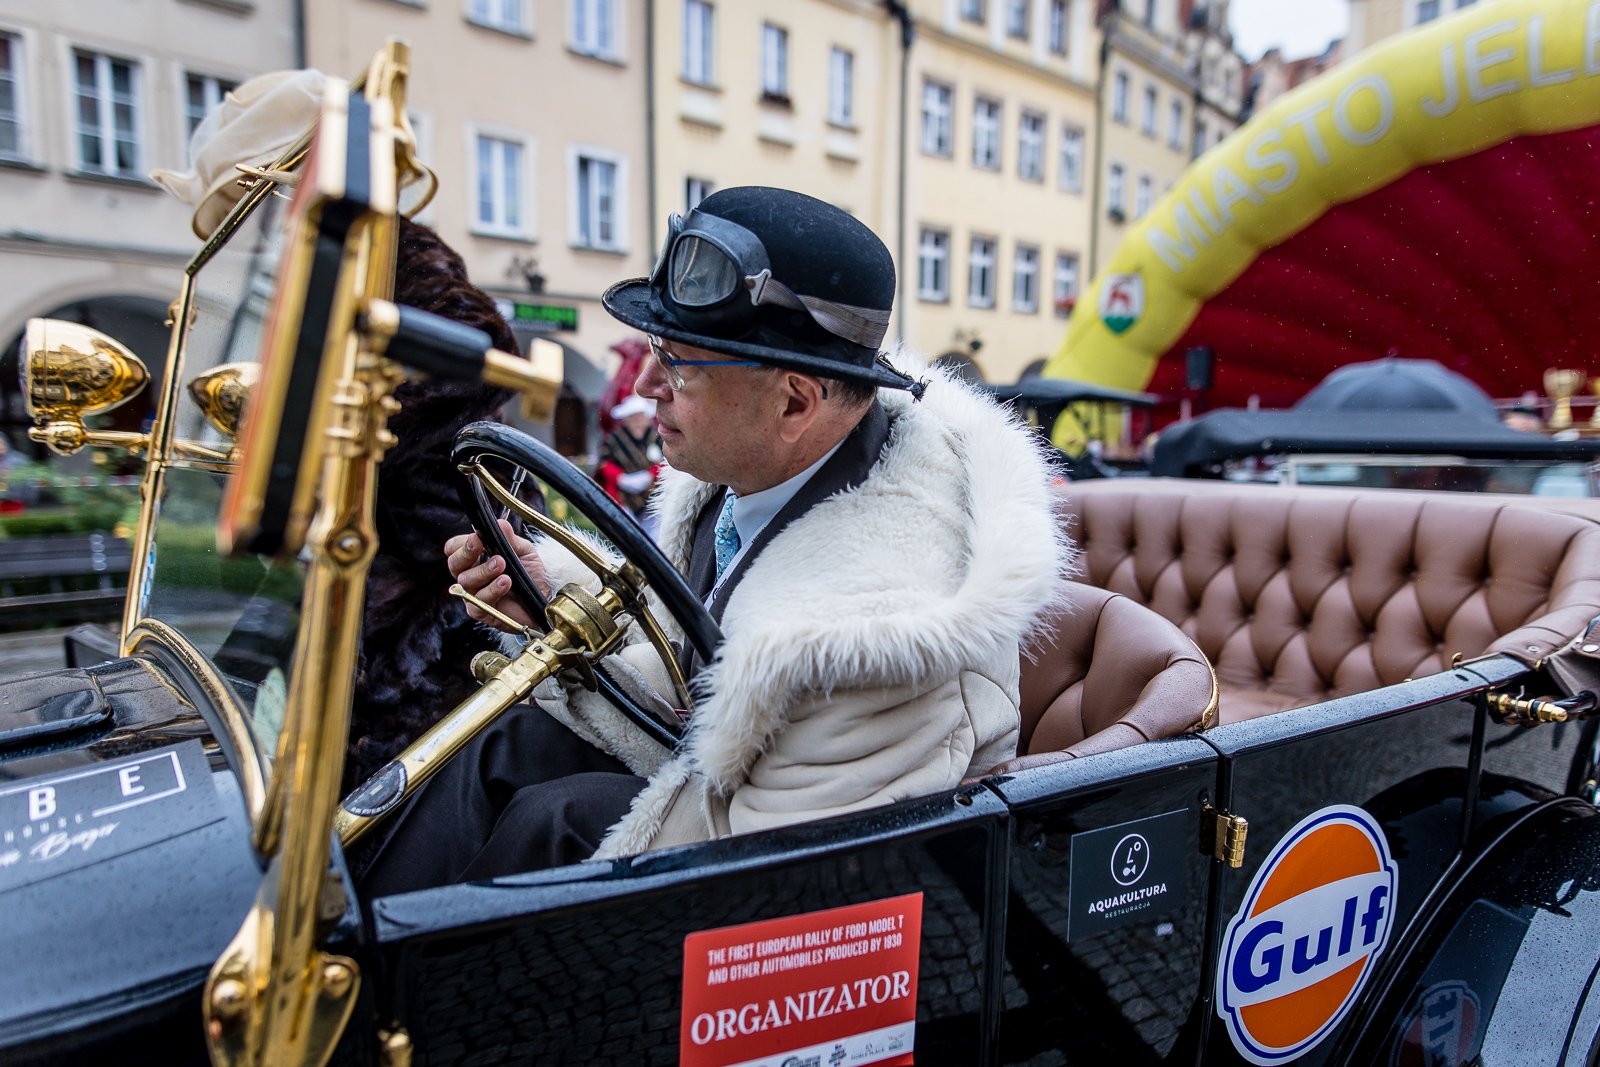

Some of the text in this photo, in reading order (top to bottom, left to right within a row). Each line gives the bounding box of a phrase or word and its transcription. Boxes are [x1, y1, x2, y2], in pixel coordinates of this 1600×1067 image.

[1146, 2, 1600, 273] MIASTO JEL
[1088, 883, 1167, 914] AQUAKULTURA
[1105, 901, 1151, 919] RESTAURACJA
[707, 968, 728, 986] AND
[730, 961, 760, 979] OTHER
[762, 949, 823, 972] AUTOMOBILES
[825, 941, 868, 957] PRODUCED
[870, 936, 881, 951] BY
[708, 914, 904, 966] THE FIRST EUROPEAN RALLY OF FORD MODEL T
[1232, 885, 1389, 994] Gulf
[690, 970, 911, 1046] ORGANIZATOR
